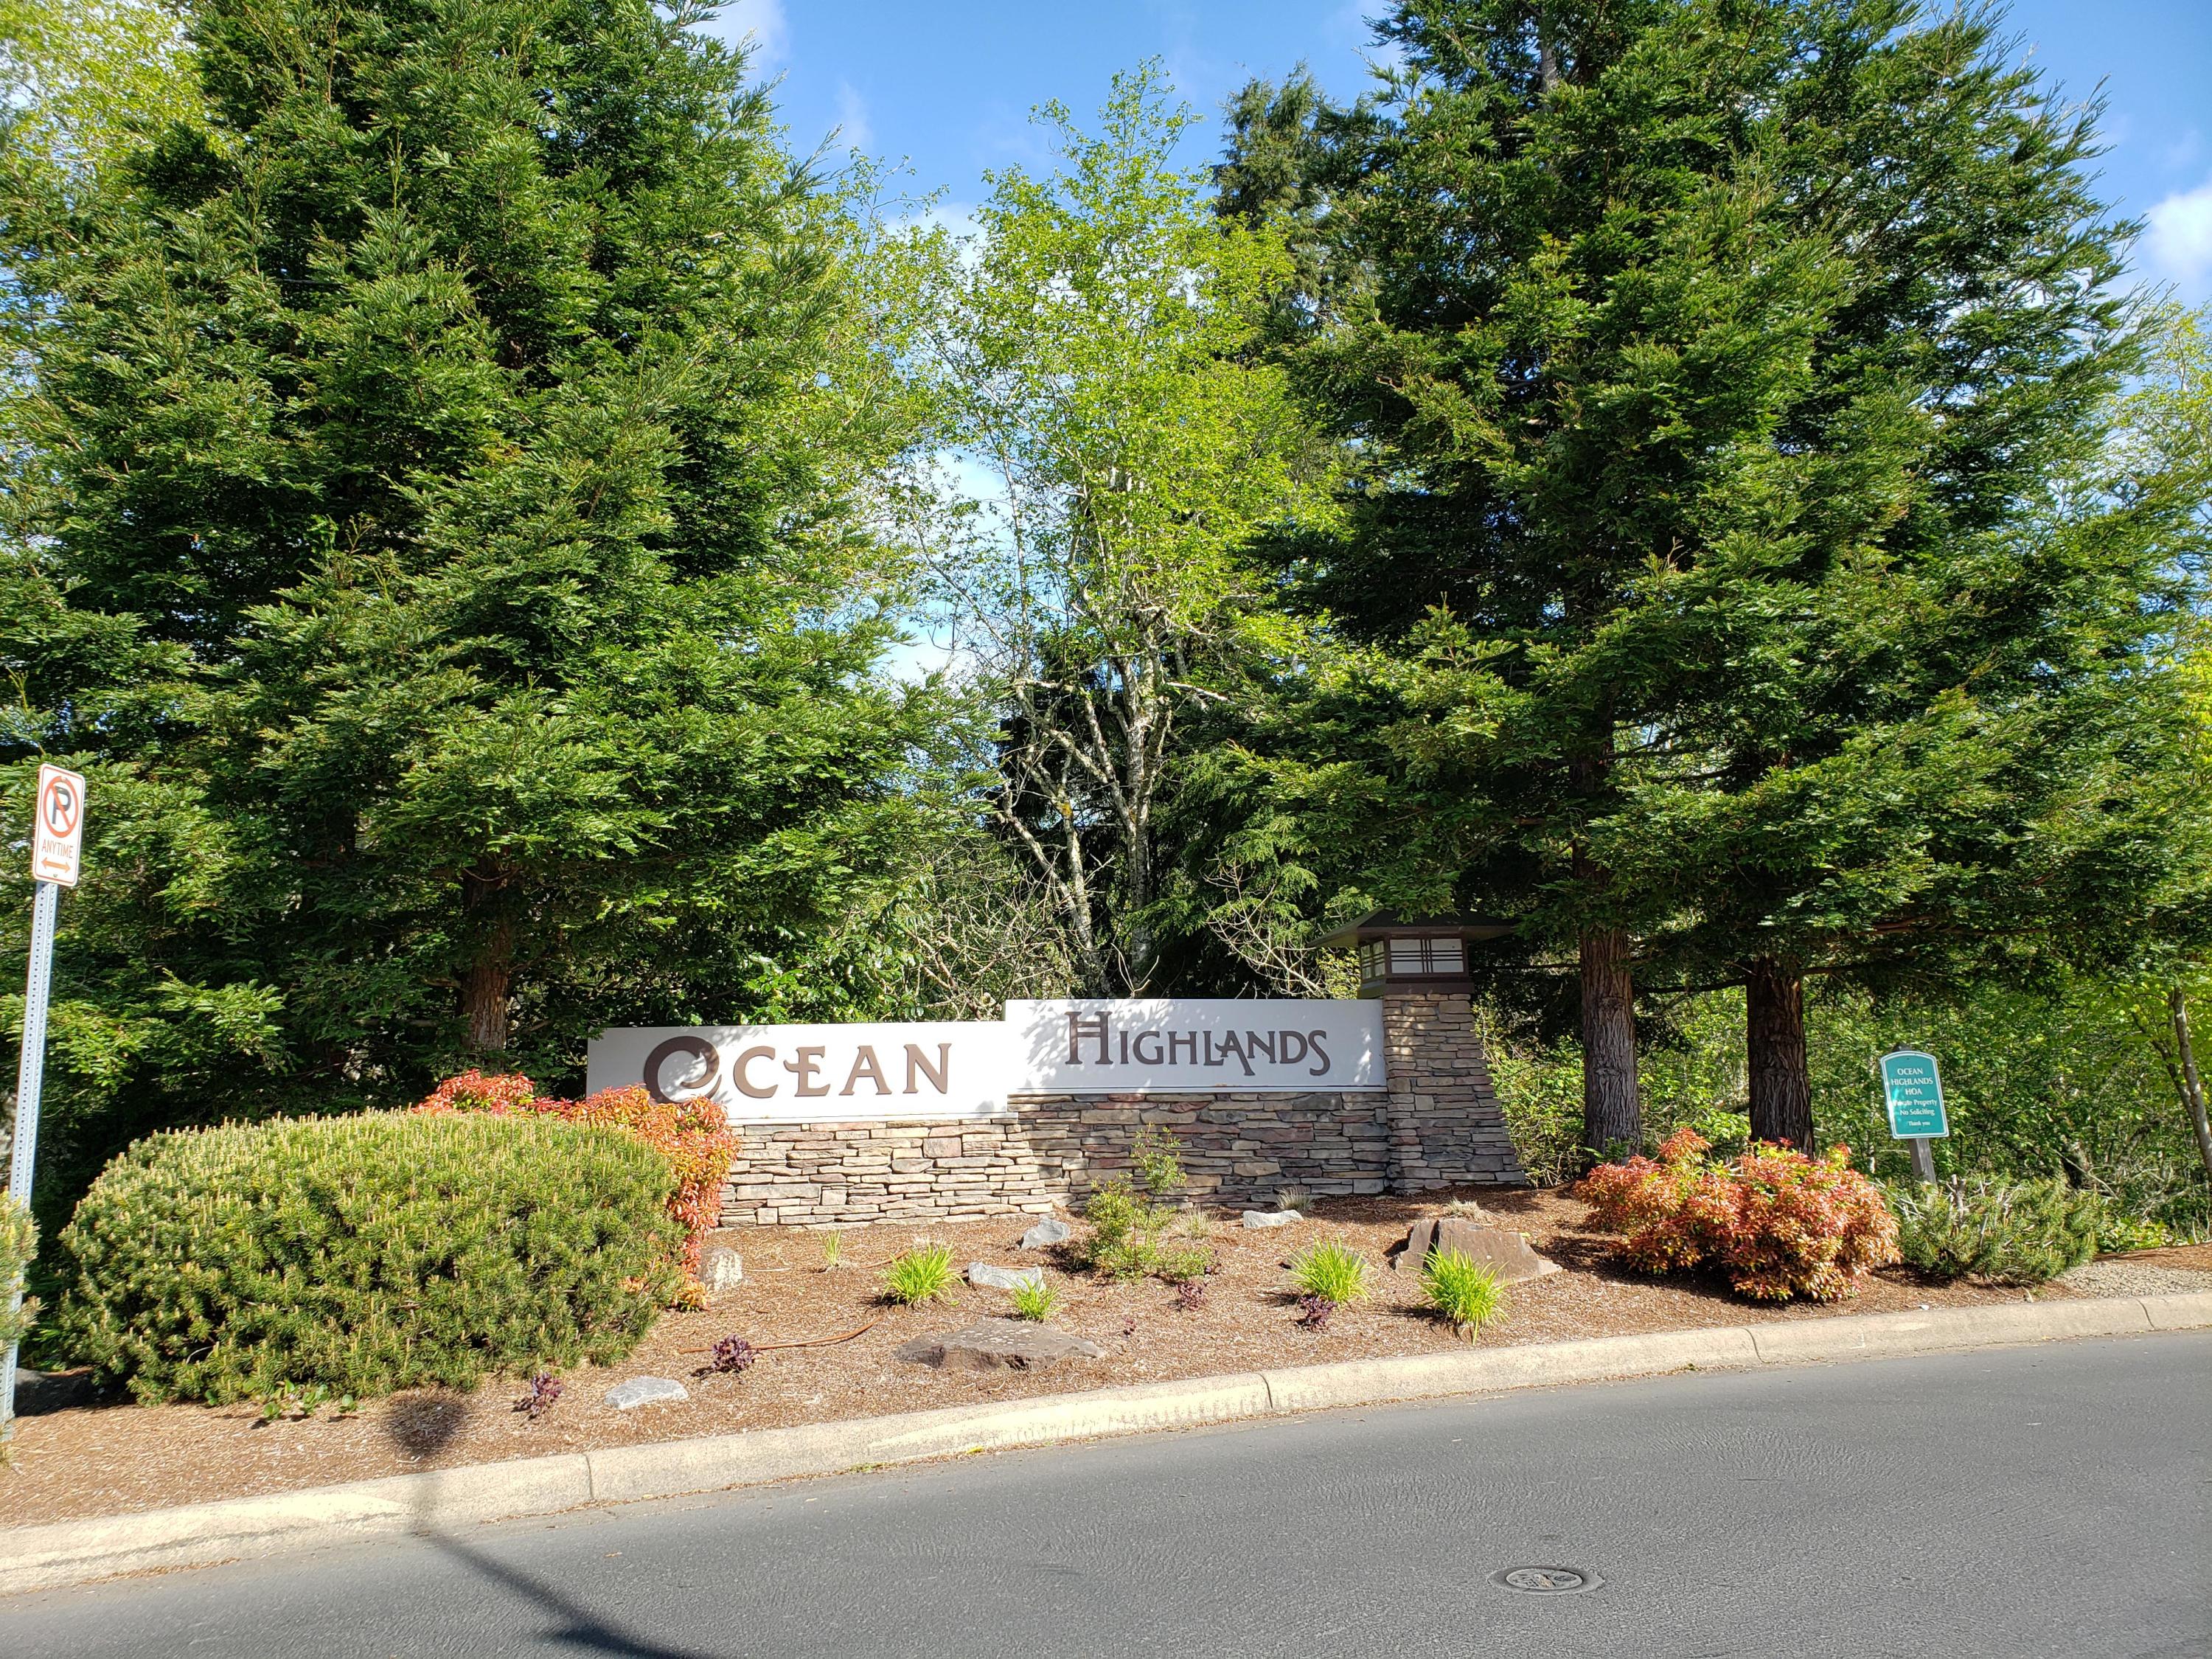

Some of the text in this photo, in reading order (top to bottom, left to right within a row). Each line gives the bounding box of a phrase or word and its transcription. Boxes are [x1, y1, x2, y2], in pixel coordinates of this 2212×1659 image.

[41, 838, 73, 859] ANYTIME
[643, 1010, 1332, 1105] OCEAN HIGHLANDS
[1891, 1077, 1933, 1085] HIGHLANDS
[1913, 1099, 1937, 1107] Property
[1909, 1108, 1935, 1116] Soliciting
